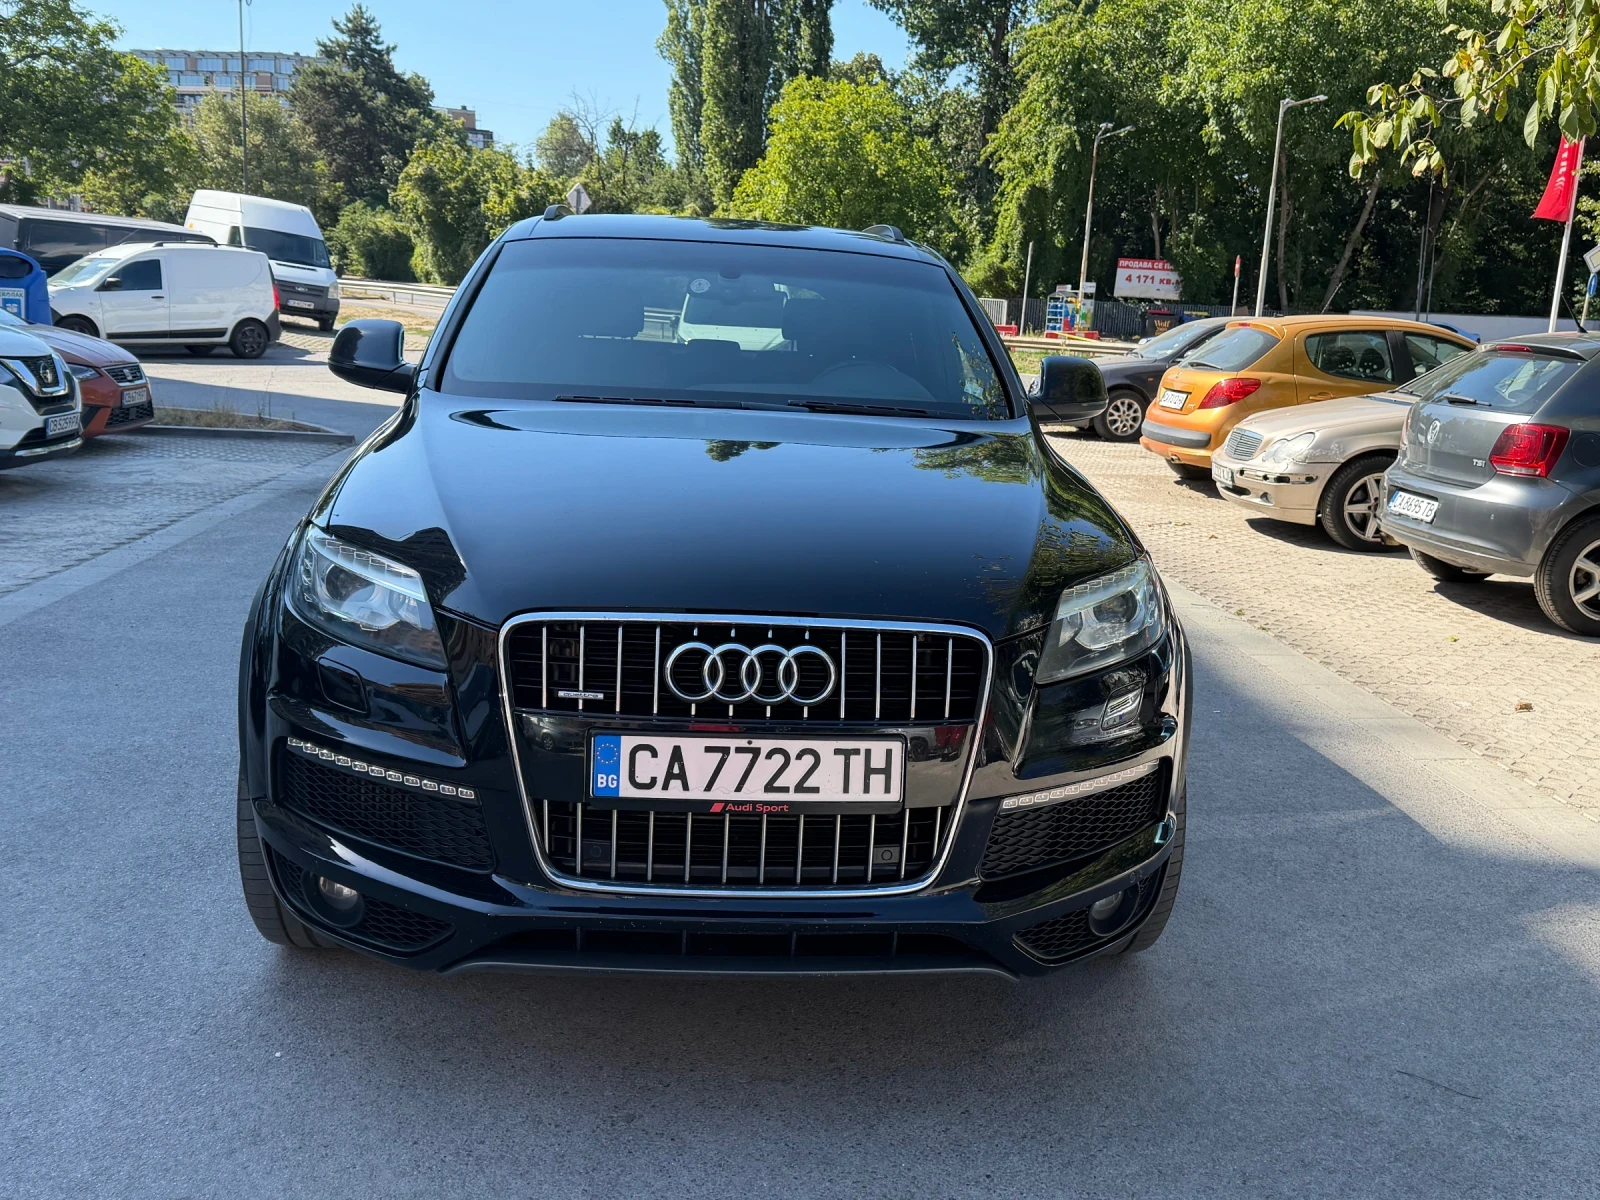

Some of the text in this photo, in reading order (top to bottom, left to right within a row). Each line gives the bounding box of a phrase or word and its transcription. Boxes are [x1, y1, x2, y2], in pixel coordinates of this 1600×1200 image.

[1119, 260, 1153, 269] ПРОДАВА
[1125, 274, 1133, 283] 4
[1136, 274, 1155, 284] 171
[628, 743, 893, 795] CA 7722 TH
[597, 773, 618, 788] BG
[726, 803, 789, 814] Audi Sport
